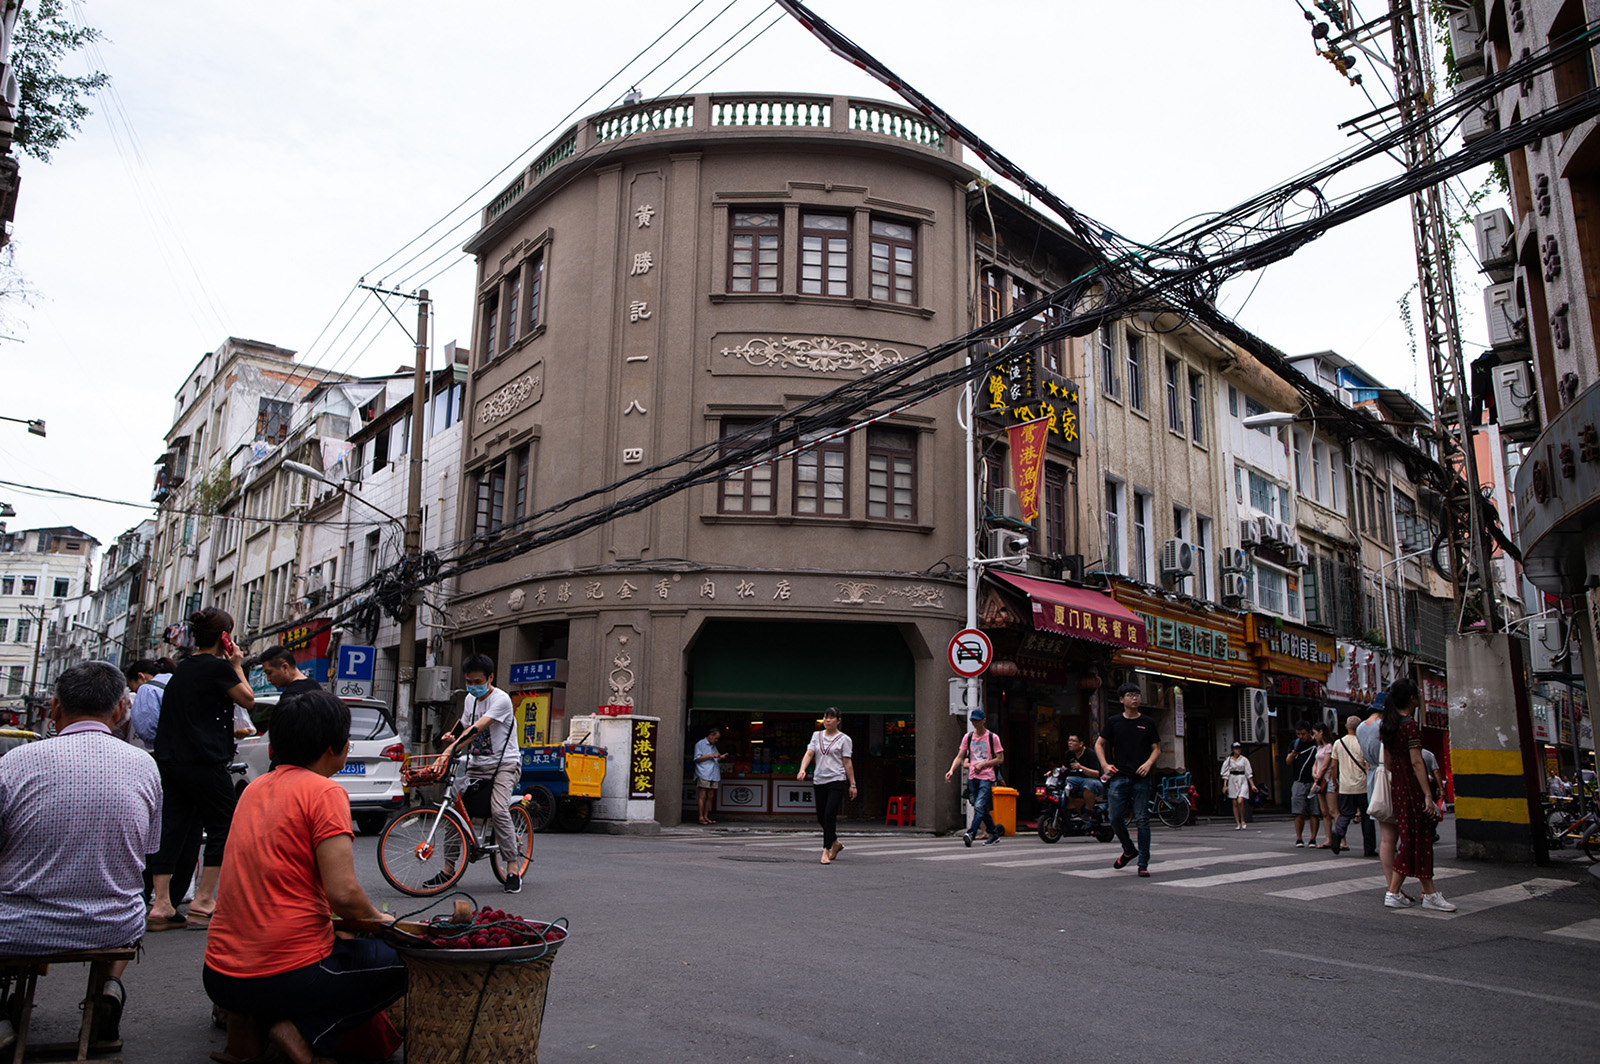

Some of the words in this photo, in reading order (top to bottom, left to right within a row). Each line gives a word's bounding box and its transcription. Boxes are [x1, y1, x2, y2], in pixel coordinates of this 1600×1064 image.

[1054, 604, 1138, 643] 厦门风味餐馆
[1280, 631, 1319, 663] 你的食堂
[346, 651, 367, 676] P
